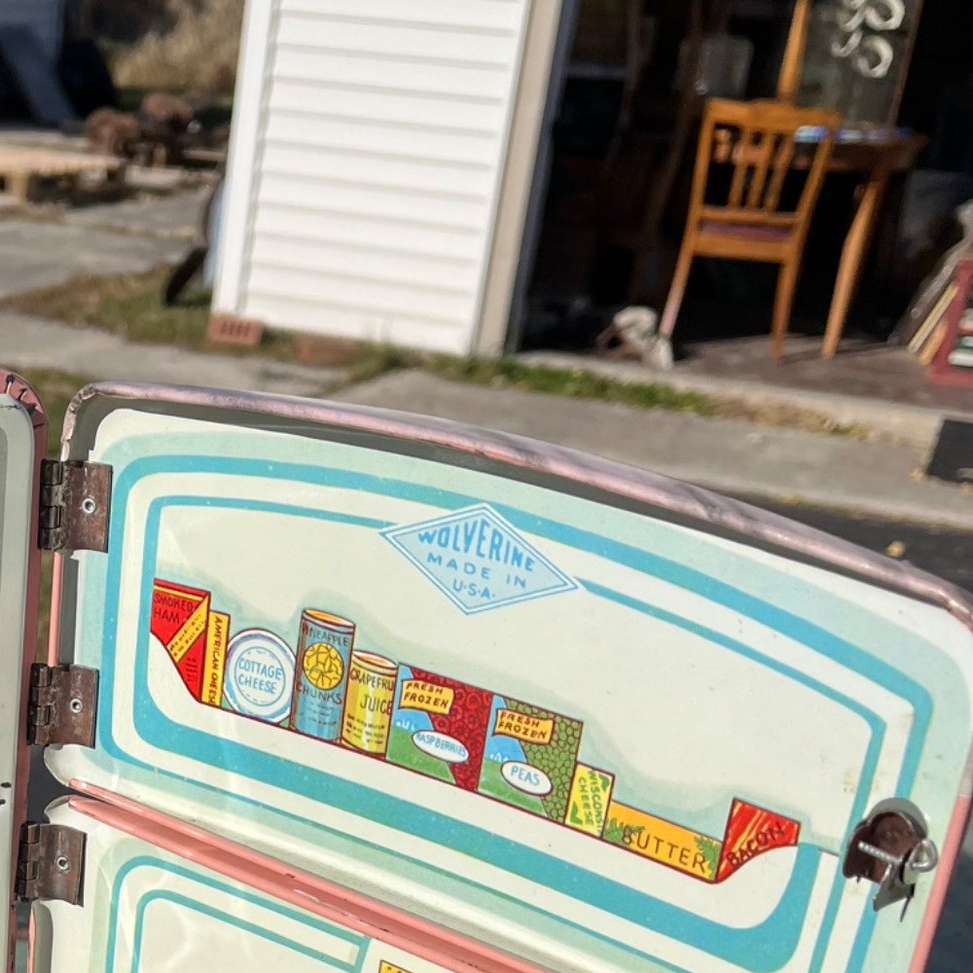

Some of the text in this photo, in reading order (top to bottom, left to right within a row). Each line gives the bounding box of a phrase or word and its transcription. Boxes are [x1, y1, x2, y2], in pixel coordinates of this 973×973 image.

[418, 518, 535, 572] WOLVERINE
[428, 552, 526, 588] MADE IN
[154, 592, 193, 612] SMOKED
[154, 608, 180, 624] HAM
[209, 616, 223, 671] AMERICAN
[238, 657, 284, 681] COTTAGE
[238, 673, 278, 695] CHEESE
[296, 682, 342, 705] CHUNKS
[406, 681, 443, 695] FRESH
[360, 693, 393, 715] JUICE
[403, 691, 449, 713] FROZEN
[500, 711, 540, 728] FRESH
[498, 722, 548, 740] FROZEN
[416, 732, 466, 757] RASPBERRIES
[510, 765, 541, 787] PEAS
[578, 776, 594, 826] CHEESE
[621, 827, 707, 874] BUTTER
[727, 821, 785, 868] BACON
